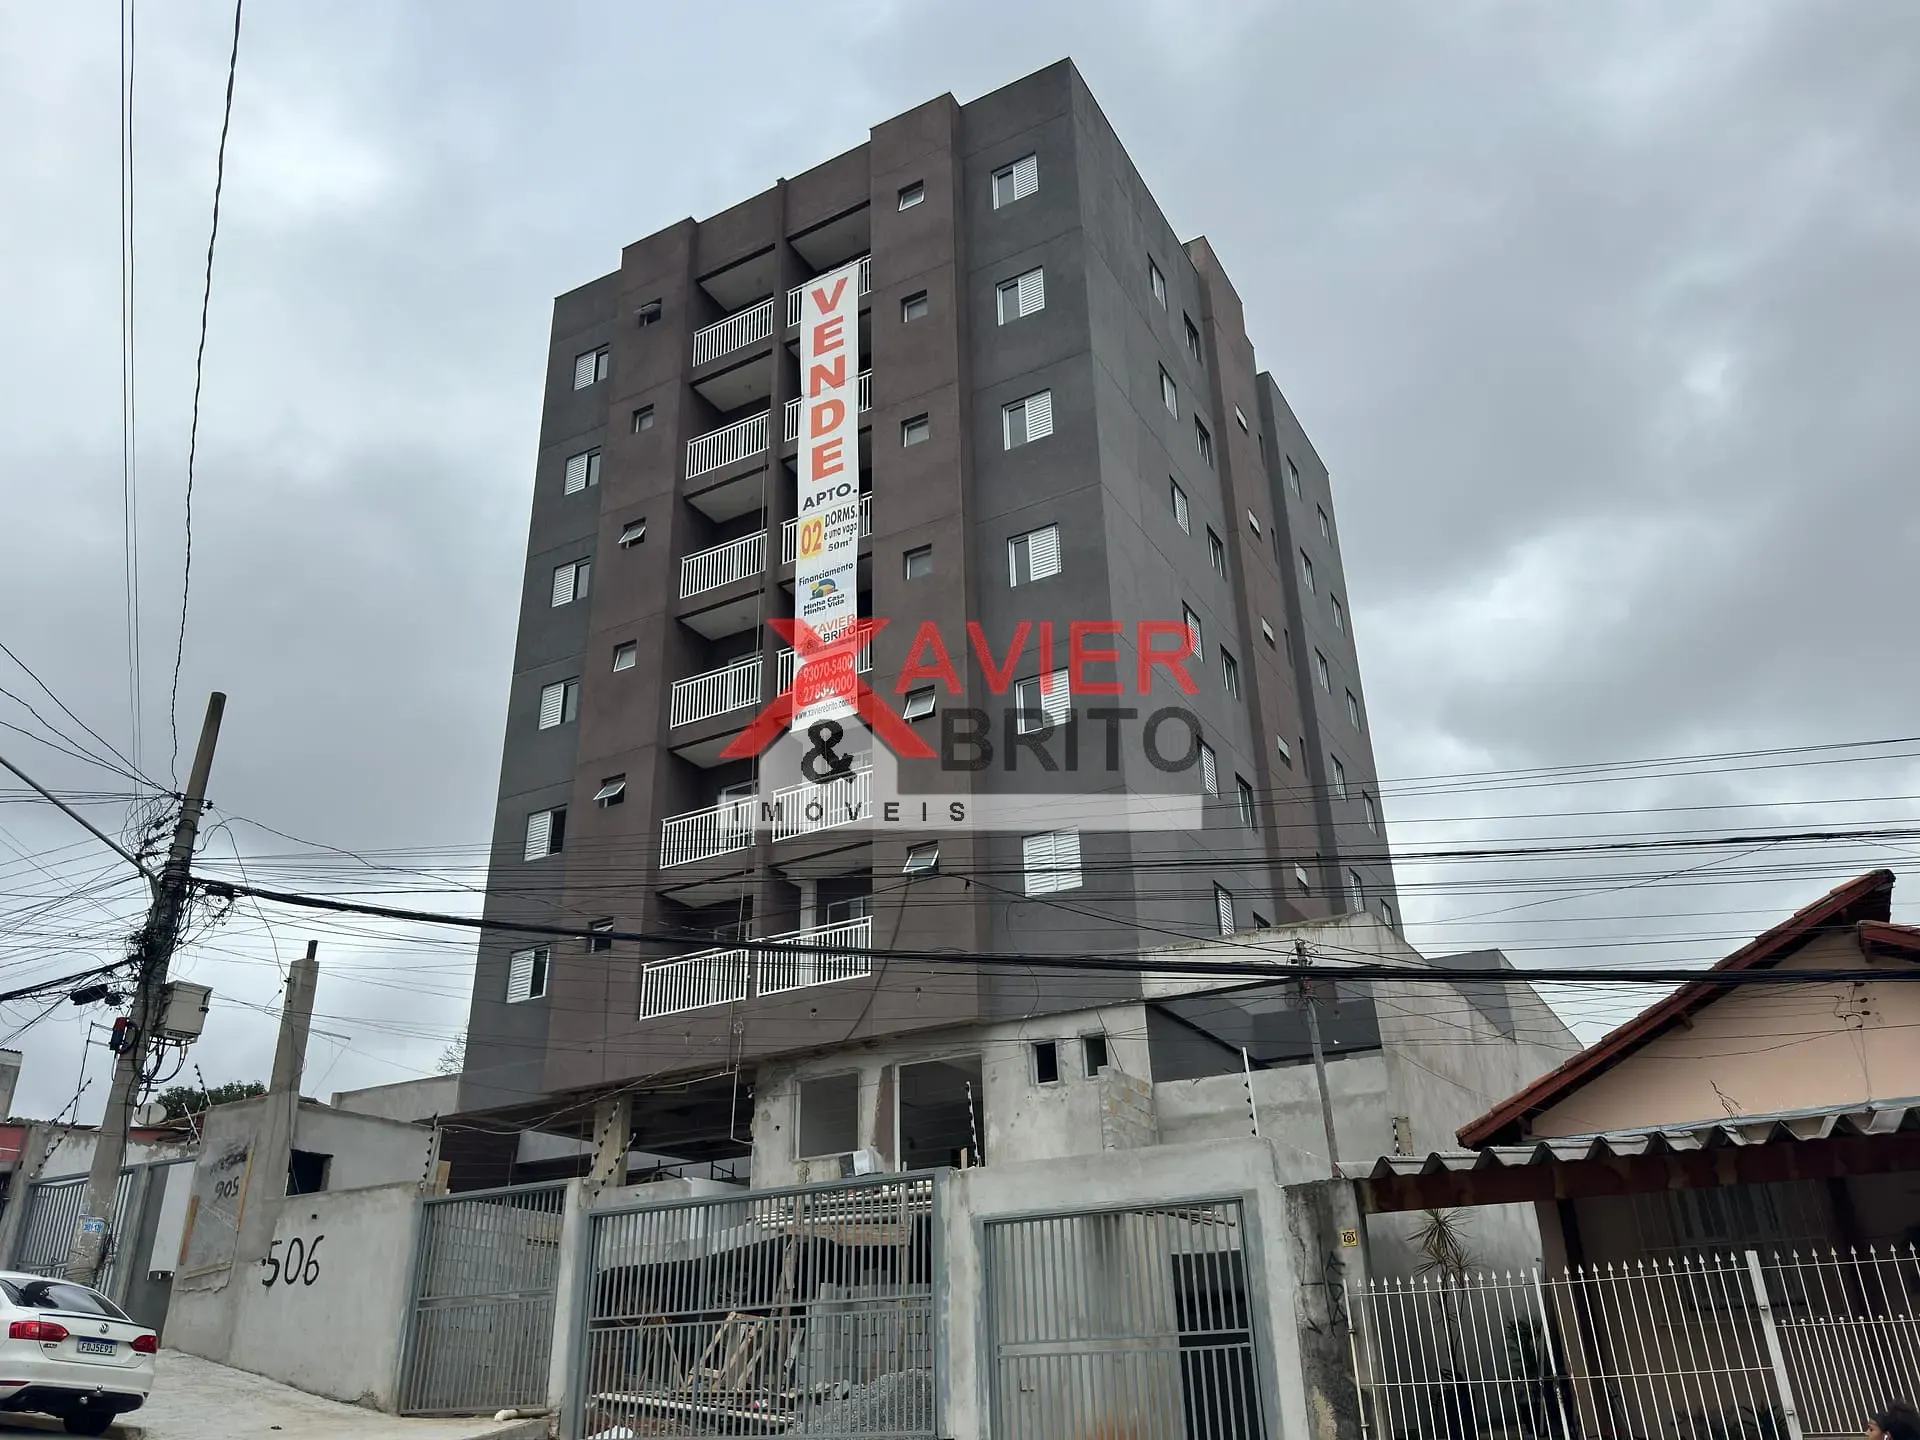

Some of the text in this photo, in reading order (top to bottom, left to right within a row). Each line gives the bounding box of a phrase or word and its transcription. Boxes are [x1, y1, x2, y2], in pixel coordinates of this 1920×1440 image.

[810, 277, 848, 482] VENDE
[803, 483, 857, 511] APTO.
[825, 505, 858, 527] DORMS.
[801, 520, 822, 555] 02
[829, 527, 841, 539] uma
[842, 523, 857, 536] vaga
[799, 562, 854, 586] Financiamento
[803, 593, 845, 611] Minha Casa
[803, 598, 845, 616] Minha Vida
[823, 625, 856, 643] BRITO
[803, 674, 853, 703] 2783-2000
[261, 1235, 325, 1287] 506
